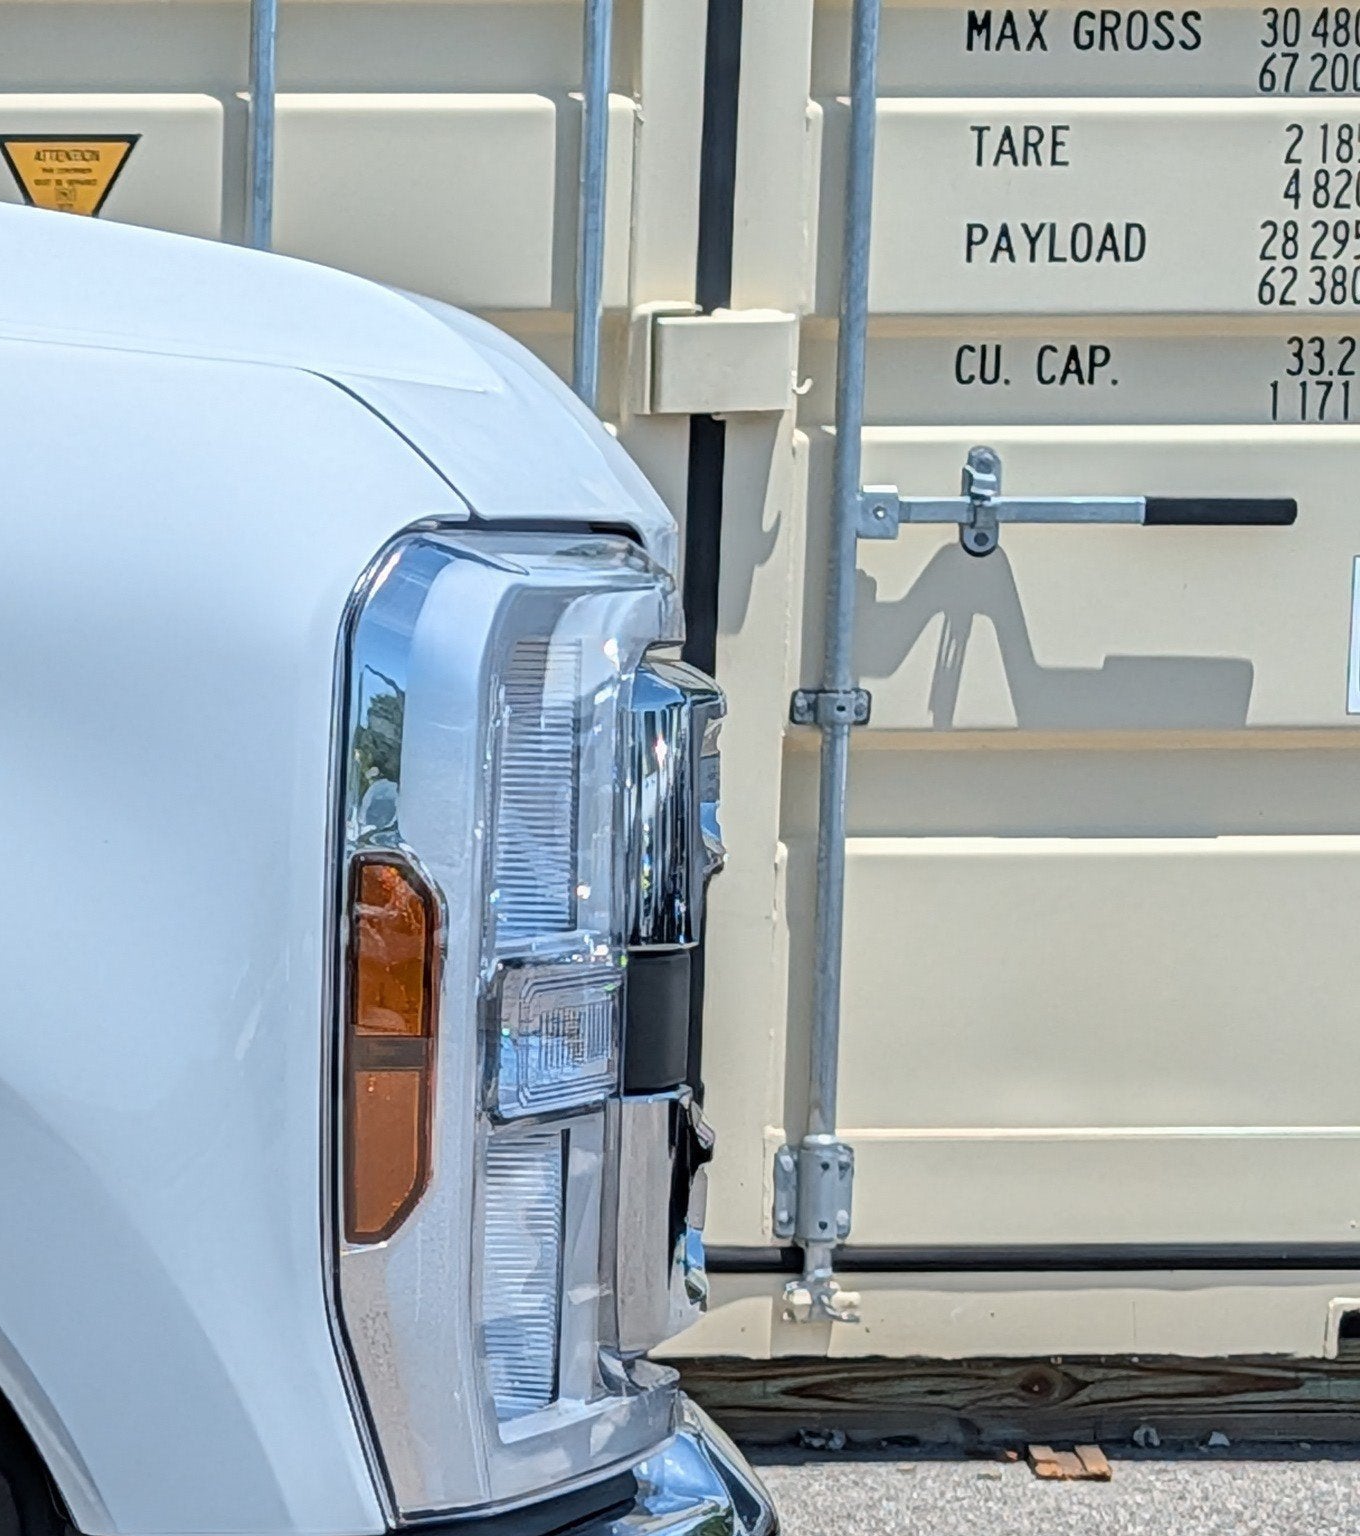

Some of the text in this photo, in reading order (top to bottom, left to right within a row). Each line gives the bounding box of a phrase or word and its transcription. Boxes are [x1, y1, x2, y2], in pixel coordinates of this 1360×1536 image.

[966, 10, 1048, 51] MAX
[1073, 10, 1202, 51] GROSS
[1261, 7, 1300, 48] 30
[1259, 52, 1299, 92] 67
[970, 125, 1070, 166] TARE
[1320, 123, 1360, 164] 18
[1312, 168, 1360, 209] 82
[965, 223, 1146, 263] PAYLOAD
[1259, 219, 1298, 260] 28
[1258, 265, 1297, 305] 62
[955, 336, 1356, 385] CU. CAP. 33.2
[1299, 380, 1350, 420] 171
